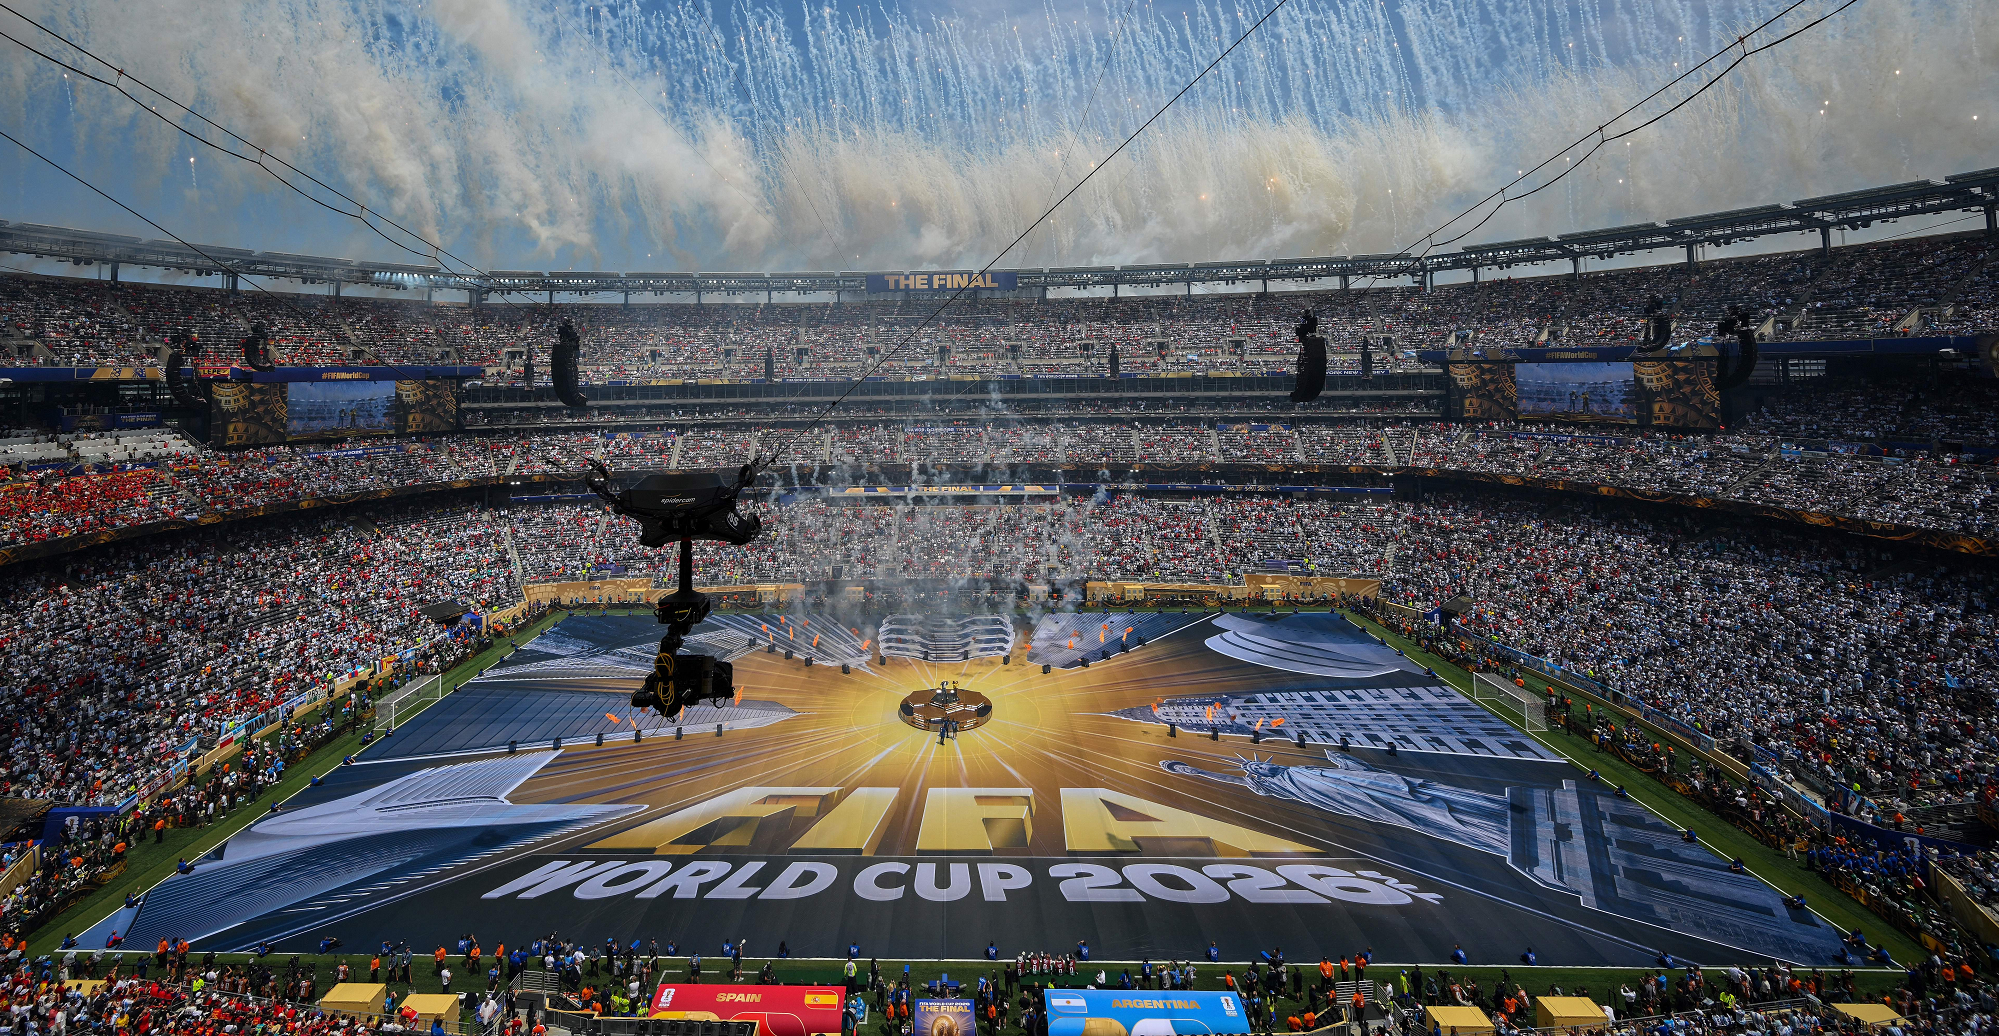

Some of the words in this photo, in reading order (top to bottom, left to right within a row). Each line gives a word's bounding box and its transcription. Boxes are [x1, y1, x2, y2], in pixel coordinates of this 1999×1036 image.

[884, 275, 928, 289] THE
[933, 273, 998, 289] FINAL
[1545, 351, 1597, 359] #FIFAWorldCup
[579, 786, 1329, 857] FIFA
[480, 860, 838, 899] WORLD
[853, 861, 1033, 901] CUP
[1049, 863, 1418, 905] 2026
[716, 993, 762, 1003] SPAIN
[1112, 999, 1201, 1009] ARGENTINA
